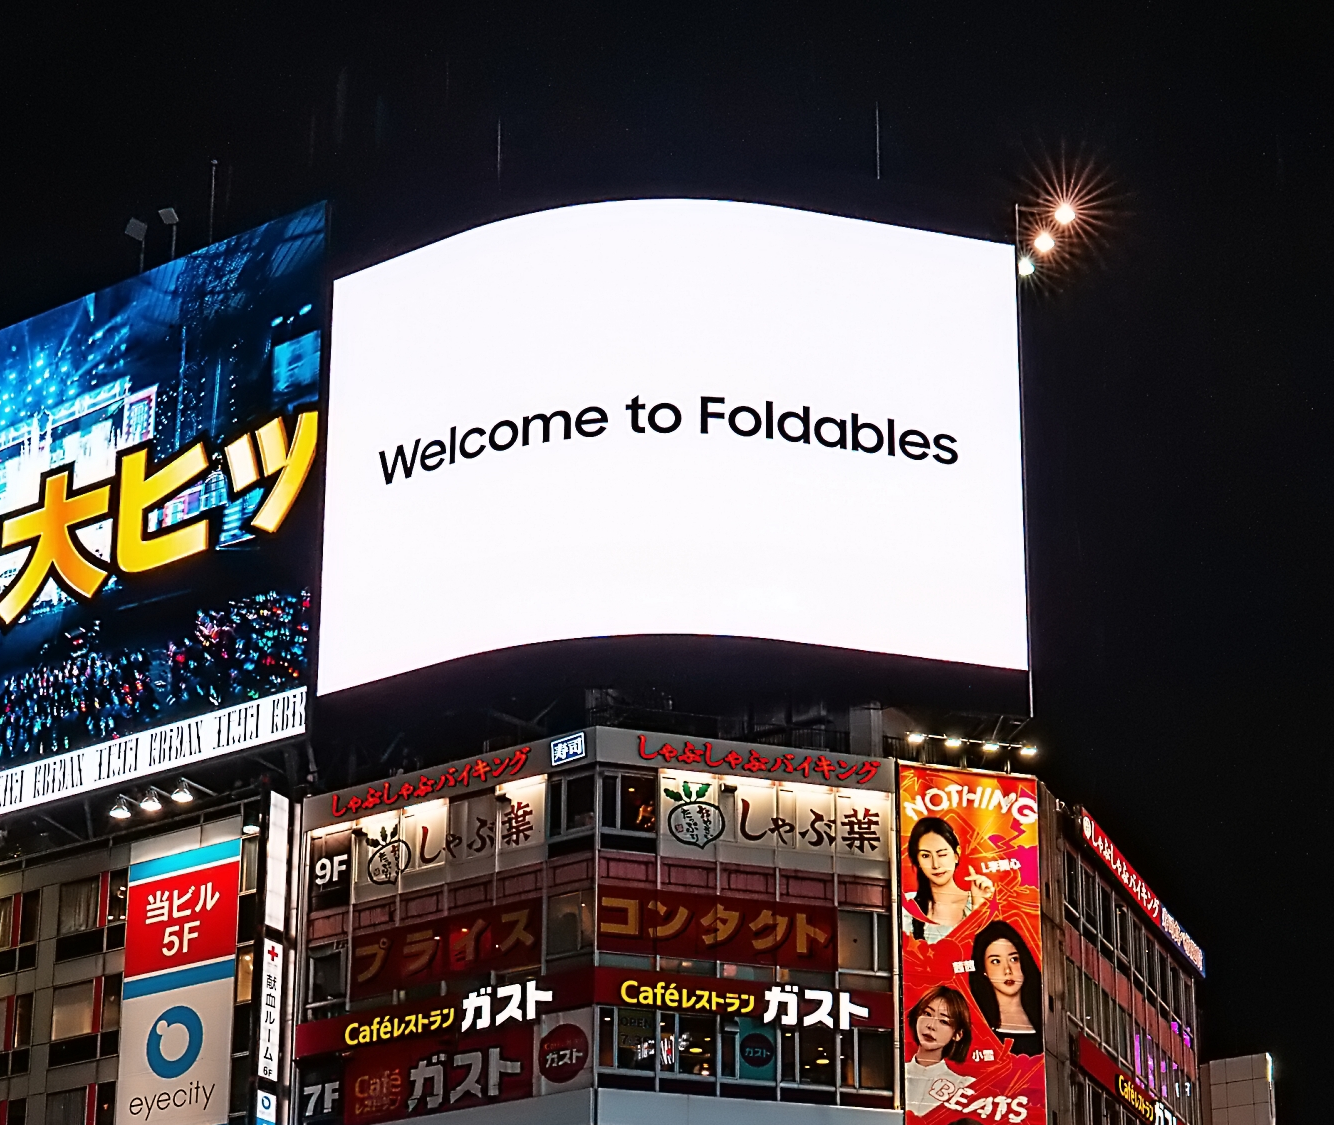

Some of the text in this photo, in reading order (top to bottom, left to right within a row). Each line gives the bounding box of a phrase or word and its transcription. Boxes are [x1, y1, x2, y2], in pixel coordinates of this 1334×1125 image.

[378, 394, 960, 485] Welcome to Foldables
[554, 737, 583, 761] 寿司
[637, 734, 882, 785] しゃぶしゃぶバイキング
[332, 747, 531, 817] しゃぶしゃぶバイキング
[904, 784, 1038, 825] NOTHING
[420, 801, 534, 864] しゃぶ葉
[739, 798, 881, 853] しゃぶ葉
[315, 854, 349, 885] 9F
[145, 882, 220, 925] 当ビル
[600, 897, 828, 953] コンタクト
[162, 920, 201, 957] 5F
[355, 908, 535, 982] プライス
[263, 974, 278, 1078] 献血ルーム 6F
[461, 980, 553, 1032] ガスト
[764, 984, 869, 1030] ガスト
[546, 1048, 583, 1068] ガスト
[744, 1046, 772, 1059] ガスト
[129, 1081, 215, 1121] eyecity
[303, 1081, 340, 1116] 7F
[408, 1047, 522, 1112] ガスト
[929, 1078, 1028, 1123] BEATS
